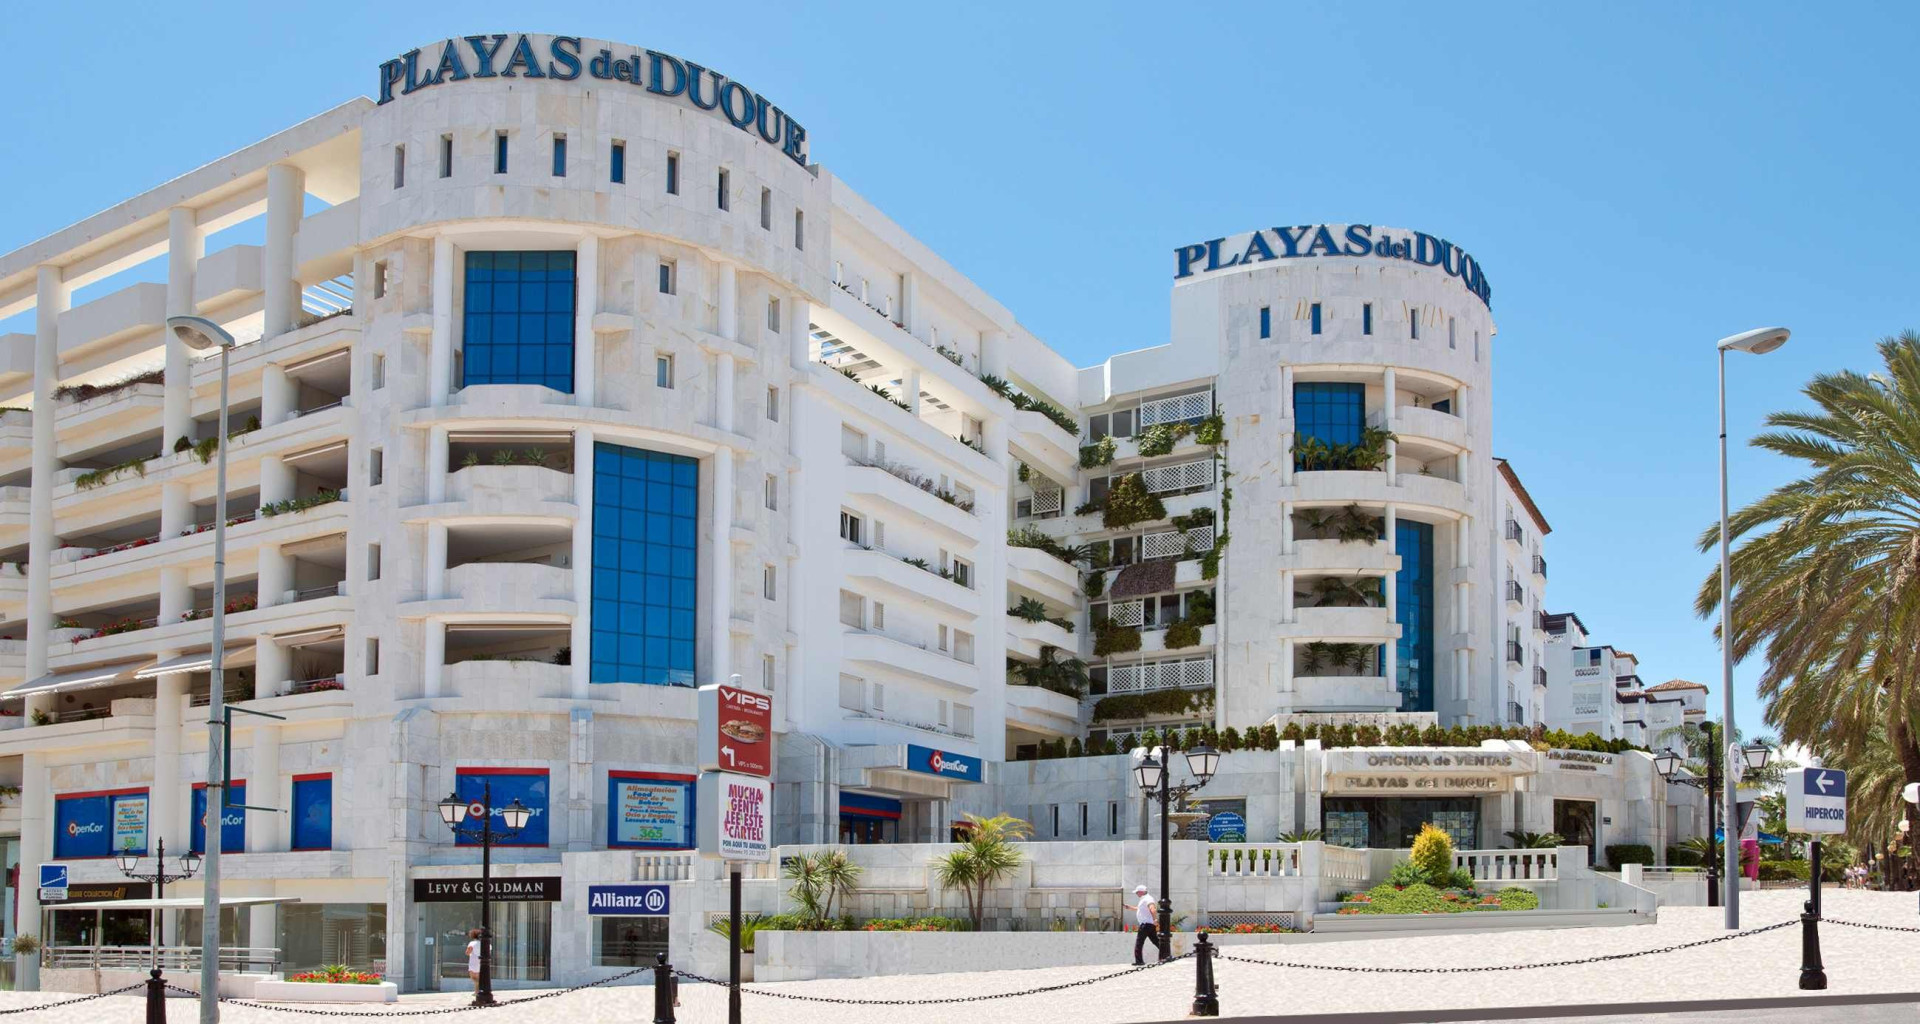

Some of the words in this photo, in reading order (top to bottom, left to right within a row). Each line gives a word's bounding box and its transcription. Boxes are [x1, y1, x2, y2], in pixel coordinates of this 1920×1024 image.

[377, 34, 581, 106] PLAYAS
[589, 49, 642, 86] del
[645, 49, 807, 167] DUQUE
[1174, 224, 1372, 280] PLAYAS
[1375, 235, 1412, 260] del
[1413, 230, 1492, 312] DUQUE
[720, 687, 770, 711] VIPS
[933, 755, 969, 773] OpenCor
[1368, 755, 1430, 767] OFICINA
[1433, 755, 1450, 766] de
[1454, 755, 1512, 767] VENTAS
[1346, 776, 1409, 788] PLAYAS
[1415, 776, 1439, 788] del
[728, 784, 763, 802] MUCHA
[468, 803, 543, 818] Oeor
[731, 798, 760, 815] GENTE
[1805, 806, 1845, 821] HIPERCOR
[726, 811, 741, 826] LEE
[744, 814, 764, 829] ESTE
[69, 822, 103, 837] OpenCor
[639, 828, 663, 839] 365
[428, 883, 458, 893] LEVY
[461, 882, 471, 893] &
[592, 892, 642, 908] Allianz
